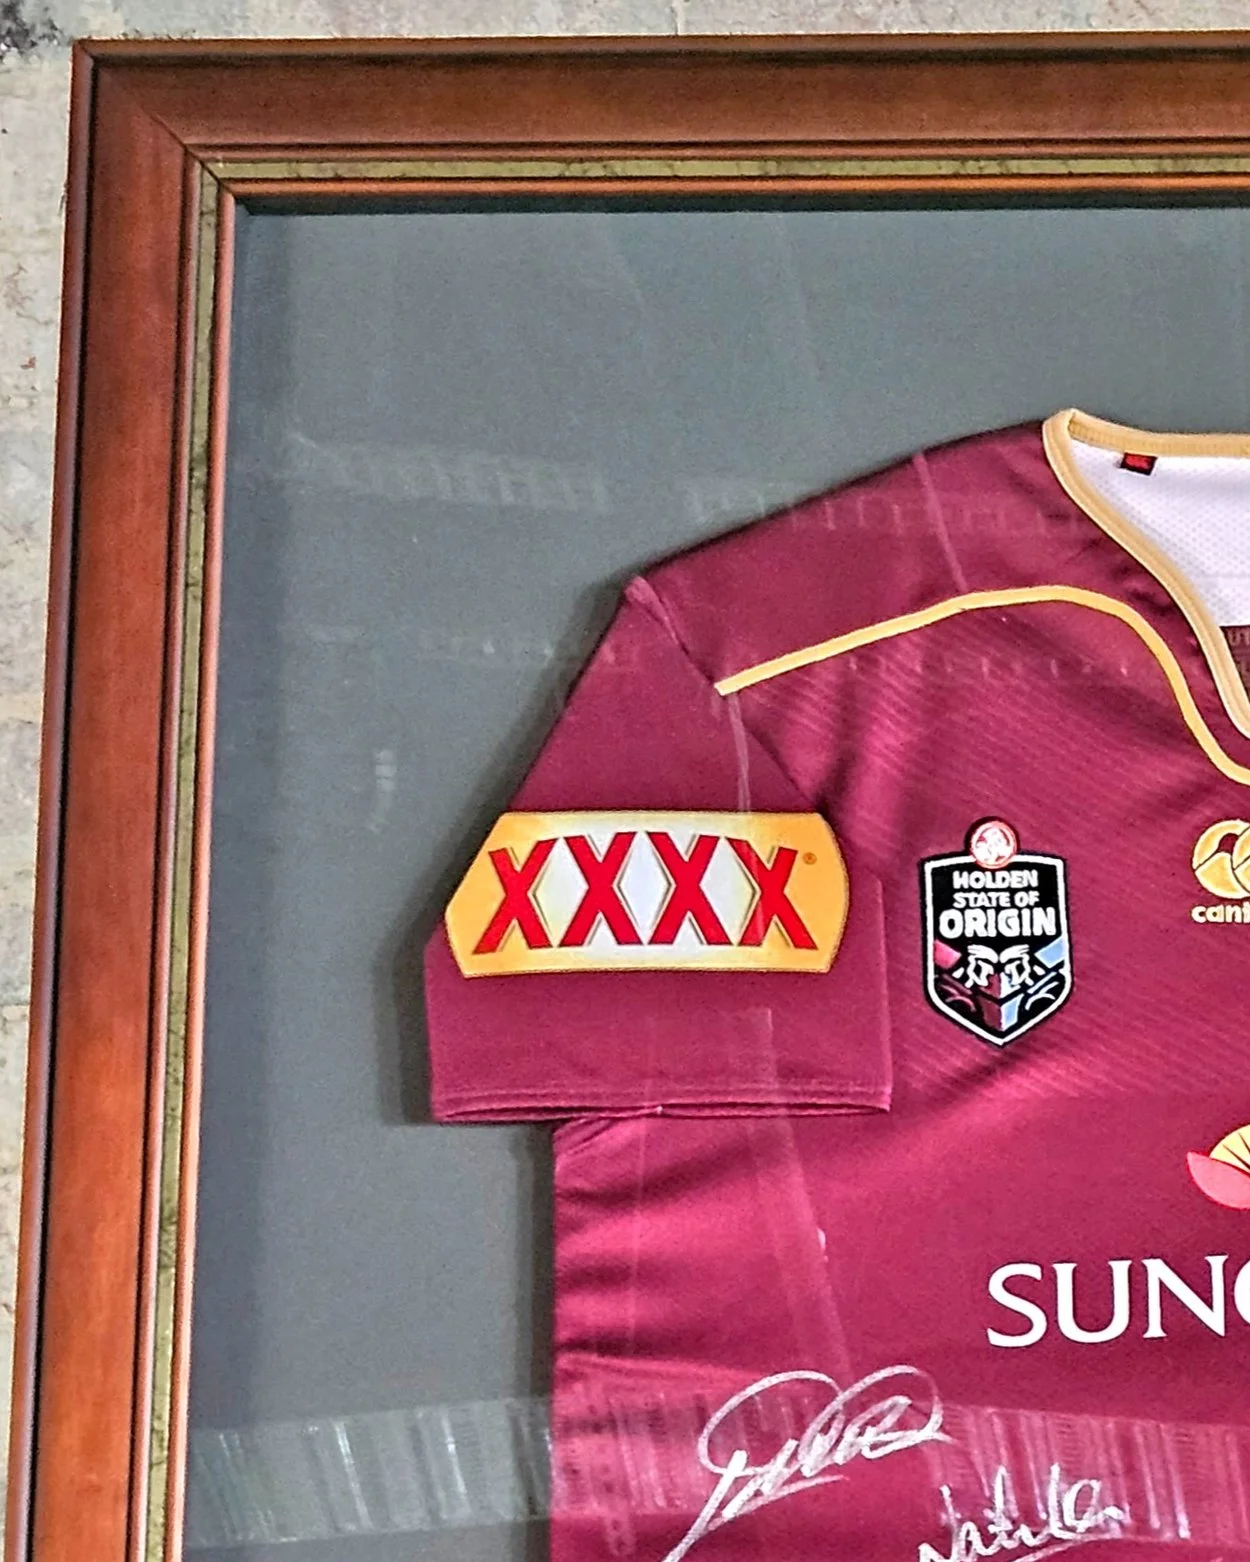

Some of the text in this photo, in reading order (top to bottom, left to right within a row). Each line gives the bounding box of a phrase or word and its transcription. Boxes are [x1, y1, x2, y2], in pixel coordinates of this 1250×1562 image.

[952, 870, 1038, 889] HOLDEN
[472, 831, 818, 955] XXXX
[953, 891, 1040, 908] STATE OF
[939, 907, 1056, 938] ORIGIN
